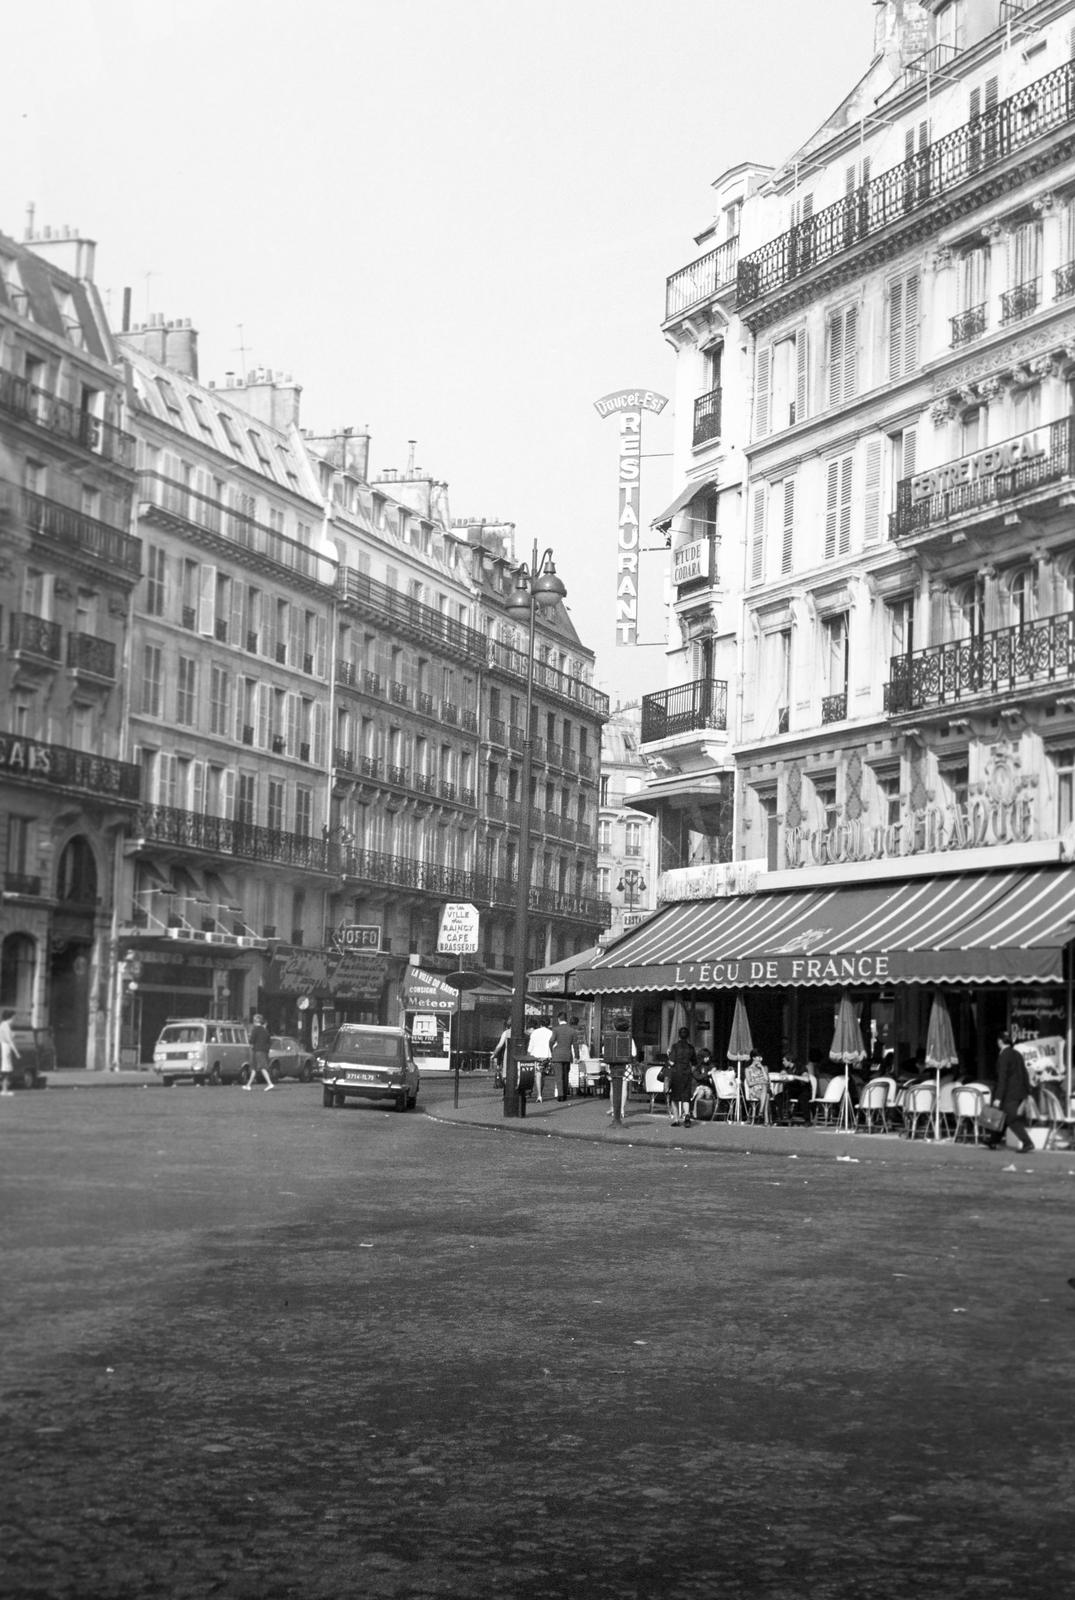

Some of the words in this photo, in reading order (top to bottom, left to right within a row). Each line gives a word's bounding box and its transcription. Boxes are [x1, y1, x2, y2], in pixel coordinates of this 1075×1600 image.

[912, 459, 970, 501] CENTRE
[616, 411, 640, 645] RESTAURANT
[675, 543, 701, 566] ETUDE
[674, 560, 701, 582] CODARA
[447, 911, 470, 919] VILLE
[338, 929, 377, 944] JOFFO
[443, 924, 474, 932] RAINCY
[439, 943, 476, 952] BRASSERIE
[750, 960, 778, 979] DE
[792, 956, 889, 979] FRANCE
[408, 996, 456, 1008] Meteor
